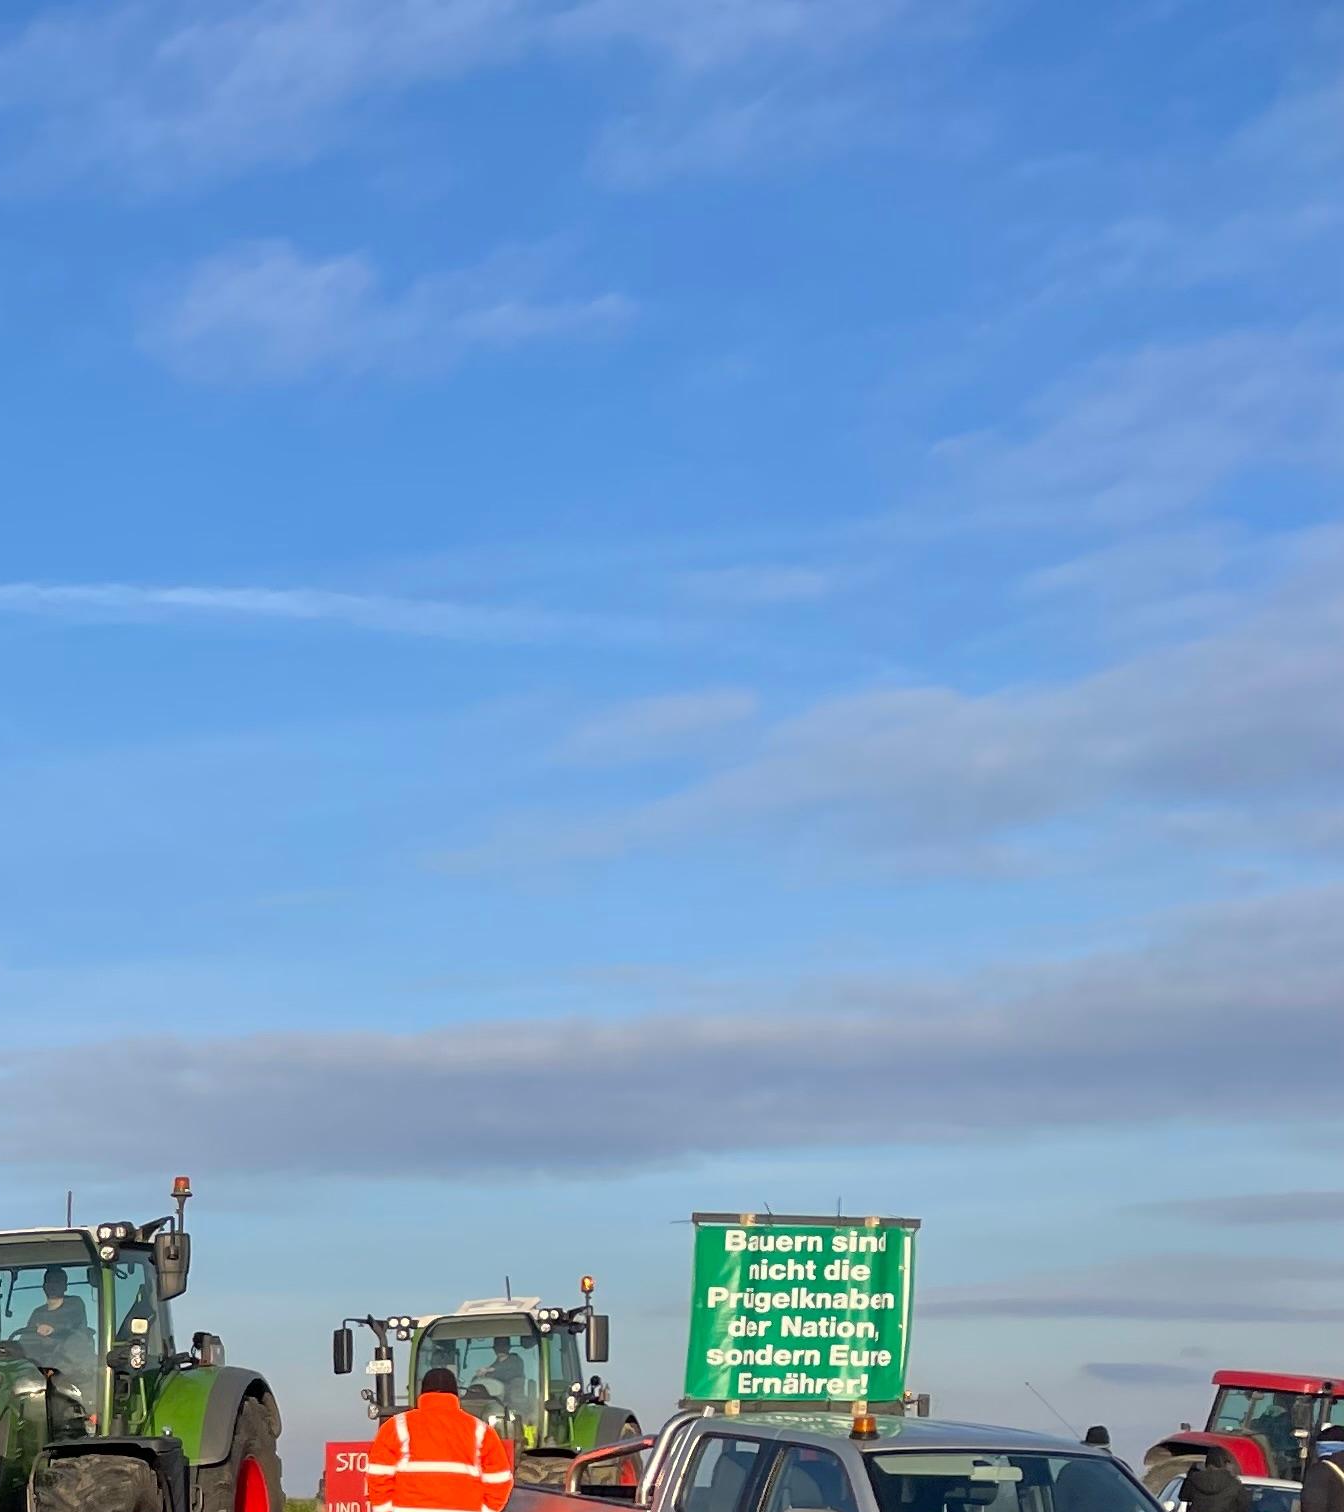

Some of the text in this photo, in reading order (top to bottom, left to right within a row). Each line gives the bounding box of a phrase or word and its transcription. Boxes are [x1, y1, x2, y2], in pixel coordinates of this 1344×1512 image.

[725, 1230, 887, 1253] Bauern sind
[749, 1259, 871, 1281] nicht die
[707, 1286, 895, 1313] Prügelknaben
[728, 1315, 879, 1342] der Nation,
[706, 1344, 891, 1367] sondern Eure
[738, 1372, 869, 1395] Ernährer!
